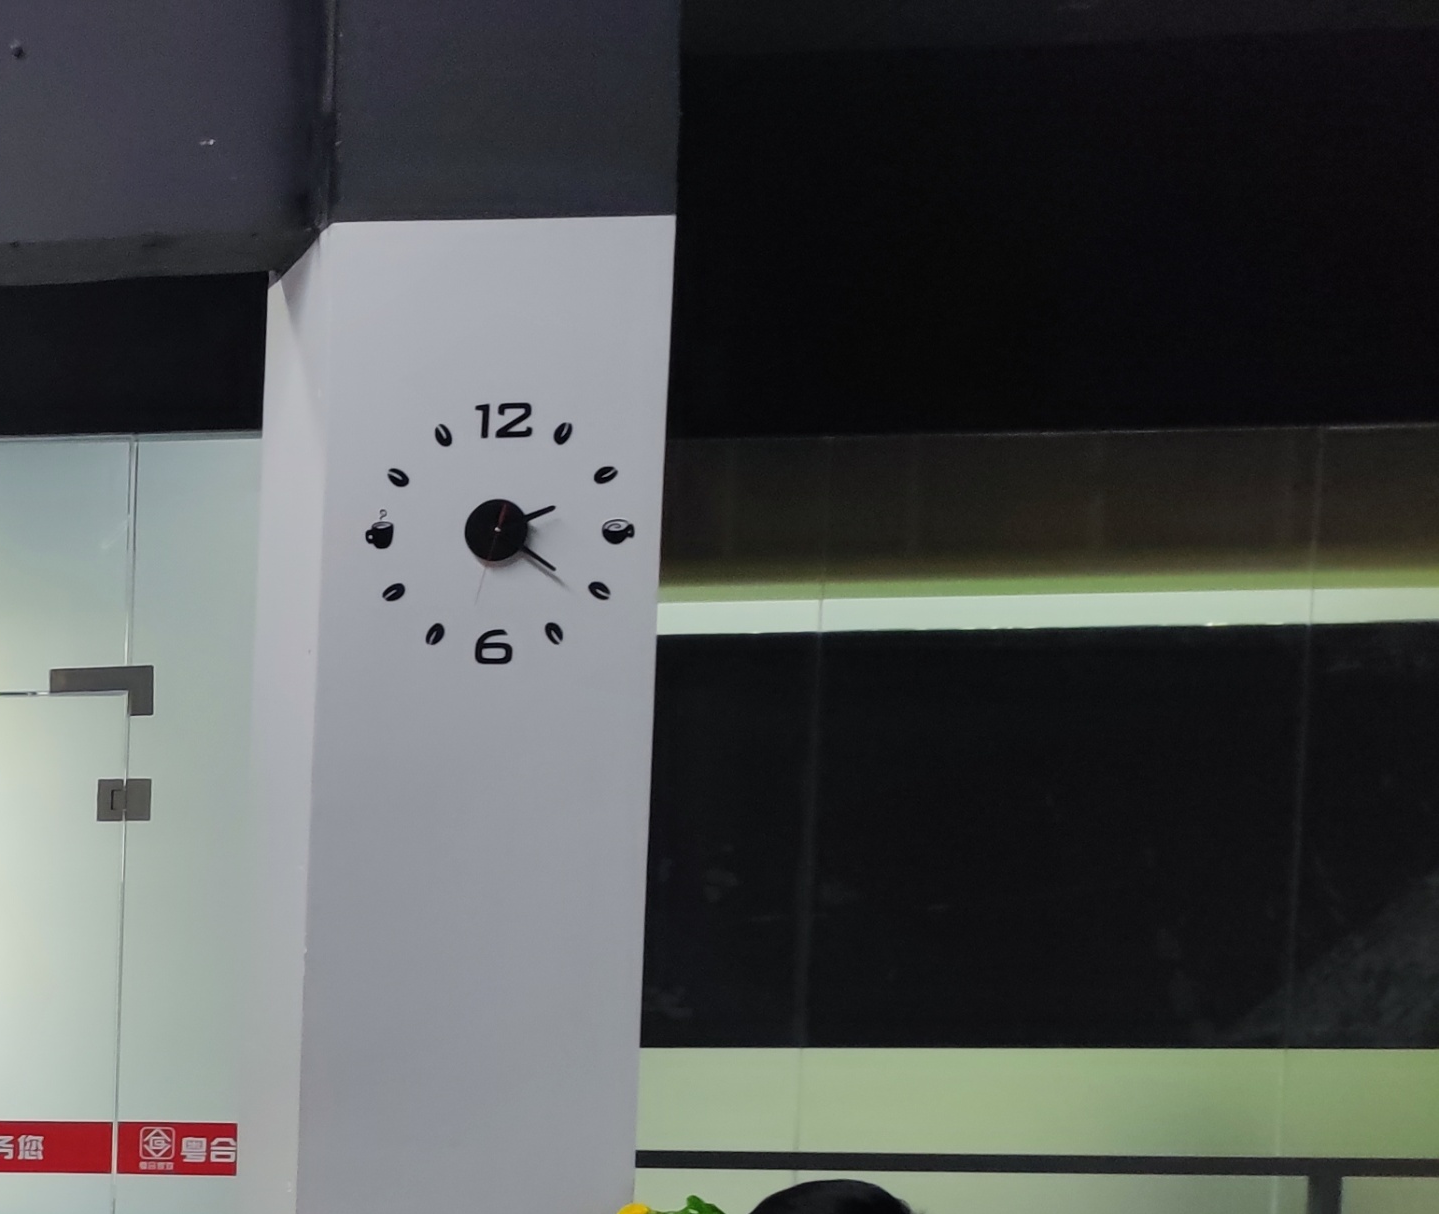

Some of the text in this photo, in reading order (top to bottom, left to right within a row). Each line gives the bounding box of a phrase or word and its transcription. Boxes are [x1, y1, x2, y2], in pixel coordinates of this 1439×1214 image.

[474, 402, 533, 438] 12
[474, 629, 513, 664] 6
[180, 1137, 237, 1163] 粤合
